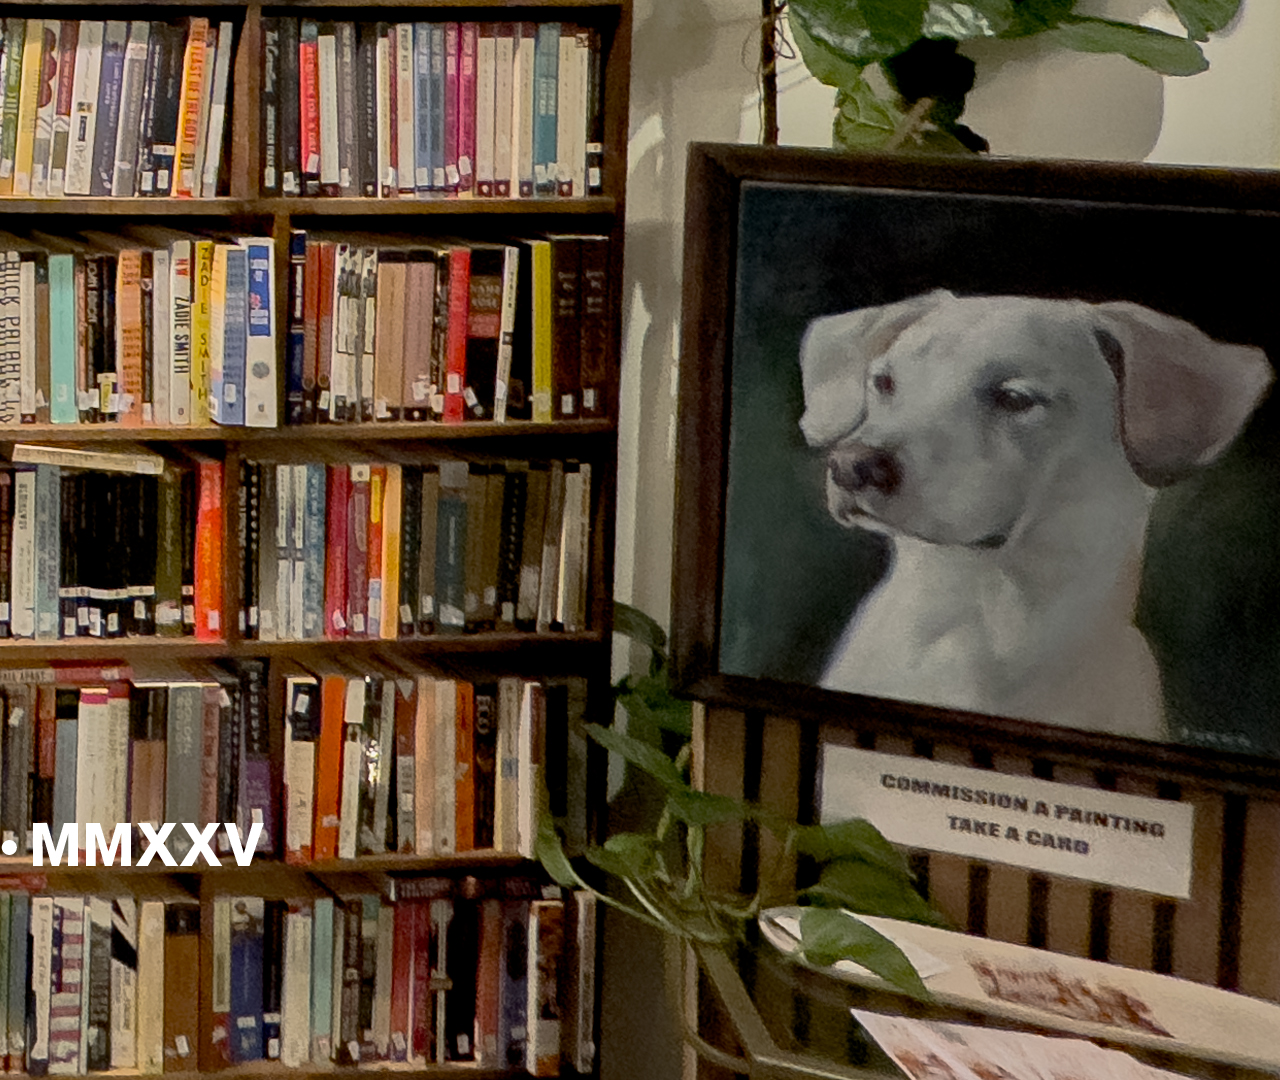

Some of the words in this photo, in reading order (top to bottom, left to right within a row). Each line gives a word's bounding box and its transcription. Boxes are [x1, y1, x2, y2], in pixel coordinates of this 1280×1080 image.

[175, 258, 188, 276] NW
[174, 297, 189, 330] ZADIE
[174, 333, 189, 374] SMITH
[880, 773, 1029, 812] COMMISSION
[1032, 800, 1049, 817] A
[1053, 804, 1166, 838] PAINTING
[946, 815, 1000, 838] TAKE
[1004, 825, 1020, 843] A
[1024, 830, 1090, 855] CARD
